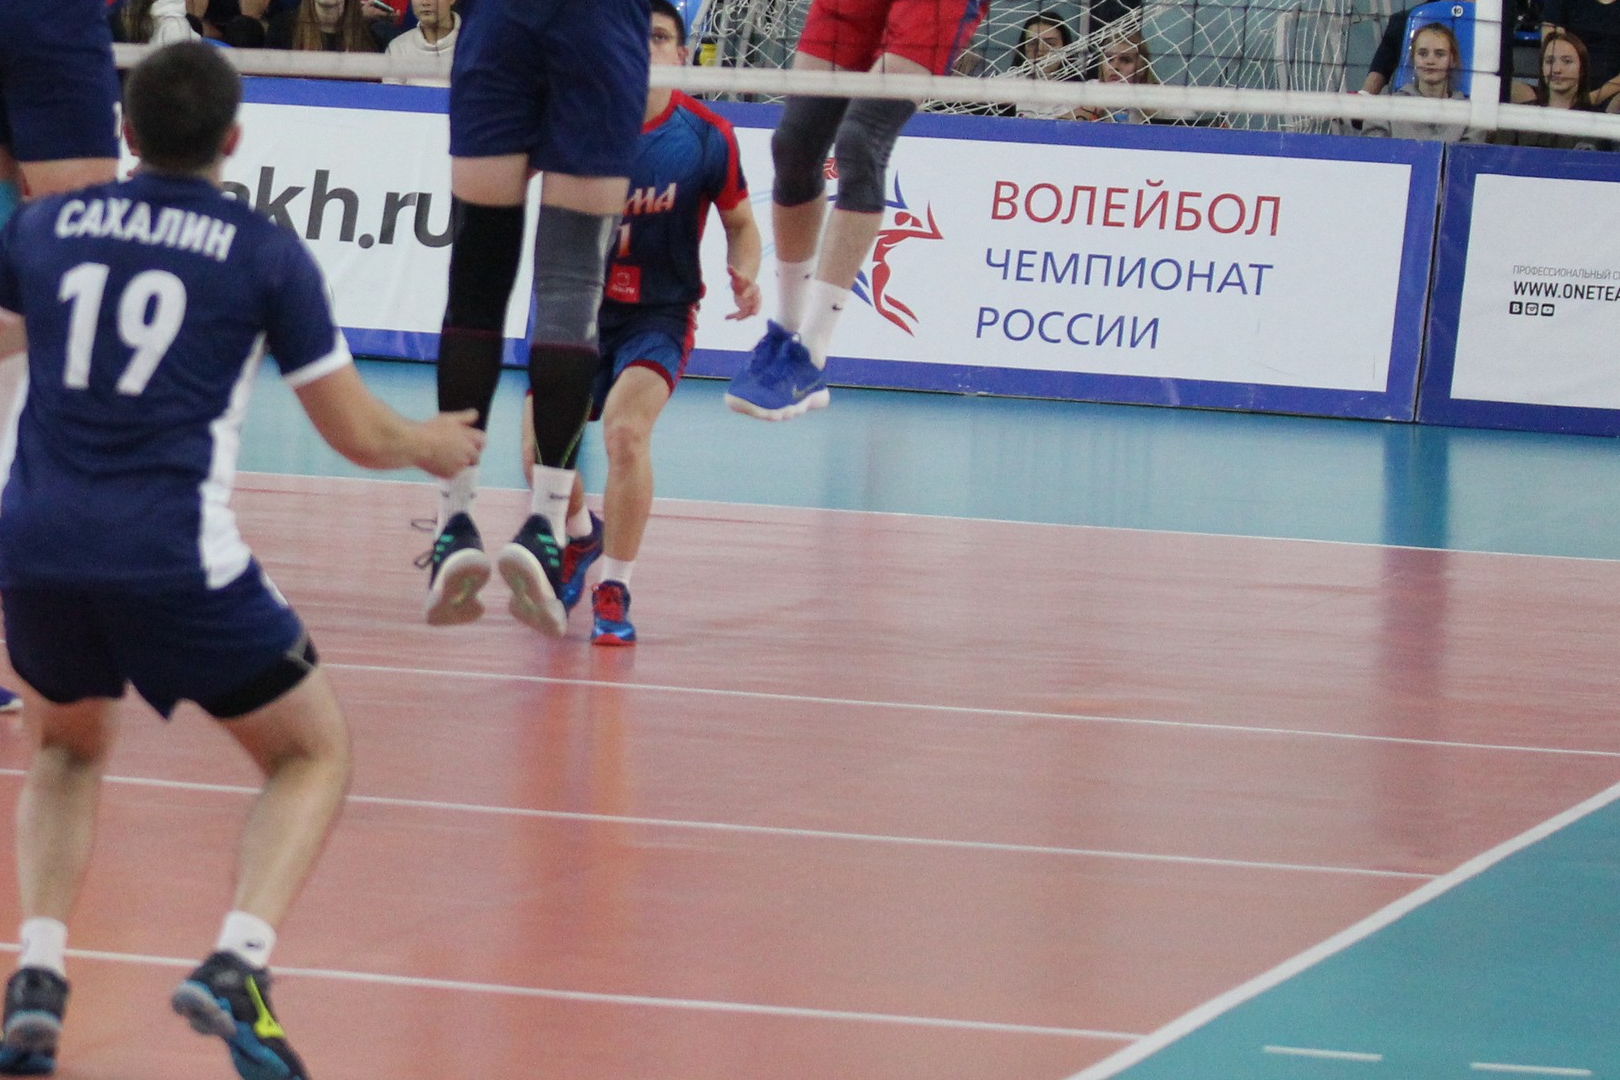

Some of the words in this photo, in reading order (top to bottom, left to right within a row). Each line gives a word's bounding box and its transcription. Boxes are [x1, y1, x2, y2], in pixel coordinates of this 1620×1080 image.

[623, 182, 677, 216] МА
[991, 179, 1281, 236] ВОЛЕЙБОЛ
[54, 197, 237, 262] САХАЛИН
[986, 248, 1274, 296] ЧЕМПИОНАТ
[1513, 265, 1611, 280] ПРОФЕССИОНАЛЬНЫЙ
[57, 262, 187, 395] 19
[976, 307, 1159, 349] РОССИИ
